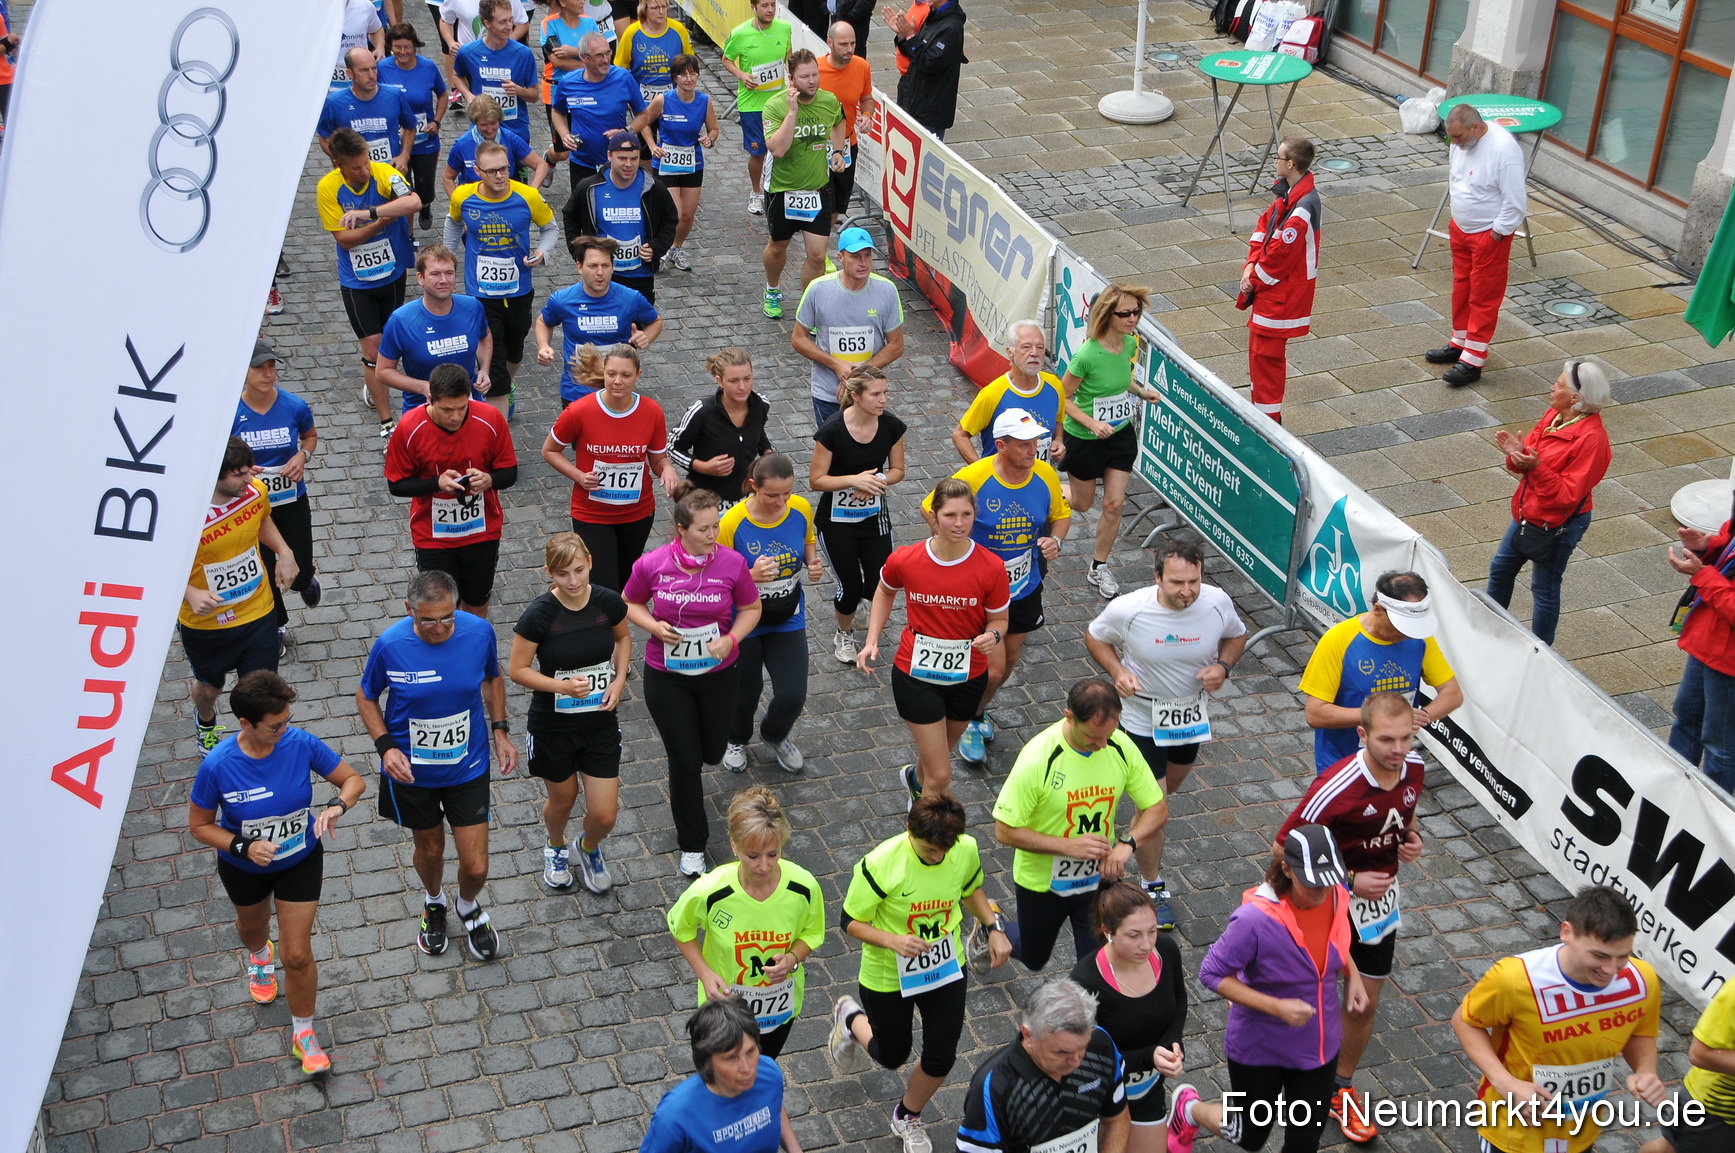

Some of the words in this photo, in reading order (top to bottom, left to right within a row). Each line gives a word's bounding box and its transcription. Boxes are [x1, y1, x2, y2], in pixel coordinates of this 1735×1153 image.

[479, 66, 511, 76] HUBER
[760, 69, 779, 82] 641
[350, 118, 388, 128] HUBER
[794, 124, 826, 137] 2012
[664, 152, 692, 166] 3389
[789, 196, 818, 209] 2320
[602, 207, 641, 217] HUBER
[355, 249, 391, 268] 2654
[481, 266, 515, 281] 2357
[578, 315, 618, 326] HUBER
[427, 335, 468, 350] HUBER
[838, 336, 867, 352] 653
[1098, 402, 1132, 421] 2138
[1171, 378, 1241, 447] Event-Leit-Systeme
[94, 333, 186, 542] BKK
[240, 426, 291, 442] HUBER
[586, 444, 640, 455] NEUMARKT
[1150, 402, 1181, 441] Mehr
[1181, 427, 1242, 496] Sicherheit
[1147, 425, 1166, 452] für
[1166, 444, 1184, 471] Ihr
[1185, 464, 1223, 508] Event!
[597, 471, 638, 488] 2167
[600, 491, 630, 499] Christina
[438, 503, 480, 523] 2166
[1145, 459, 1162, 482] Miet
[1161, 476, 1170, 492] &
[1168, 480, 1195, 515] Service
[1193, 506, 1213, 532] Line:
[1212, 521, 1235, 554] 09181
[1235, 541, 1256, 571] 6352
[201, 523, 232, 546] MAX
[233, 501, 264, 527] BÖGL
[445, 523, 474, 533] Andreas
[213, 559, 259, 591] 2539
[229, 585, 253, 599] Marco
[909, 591, 968, 607] NEUMARKT
[679, 660, 709, 669] Henrike
[918, 648, 966, 671] 2782
[926, 671, 953, 681] Sabine
[51, 577, 145, 810] Audi
[571, 697, 600, 707] Jasmin
[1158, 704, 1202, 728] 2663
[416, 724, 467, 748] 2745
[432, 751, 454, 759] Ernst
[1452, 737, 1469, 758] die
[1469, 751, 1517, 809] verbinden
[1067, 785, 1116, 803] Müller
[1076, 811, 1103, 835] M
[910, 899, 955, 913] Müller
[1356, 888, 1397, 924] 2932
[734, 930, 793, 944] Müller
[918, 921, 941, 940] M
[905, 938, 952, 973] 2630
[923, 972, 941, 983] Rita
[749, 992, 790, 1016] 072
[1543, 1021, 1593, 1044] MAX
[1598, 1006, 1646, 1032] BÖGL
[1535, 1069, 1563, 1080] PARTL
[1543, 1071, 1606, 1099] 2460
